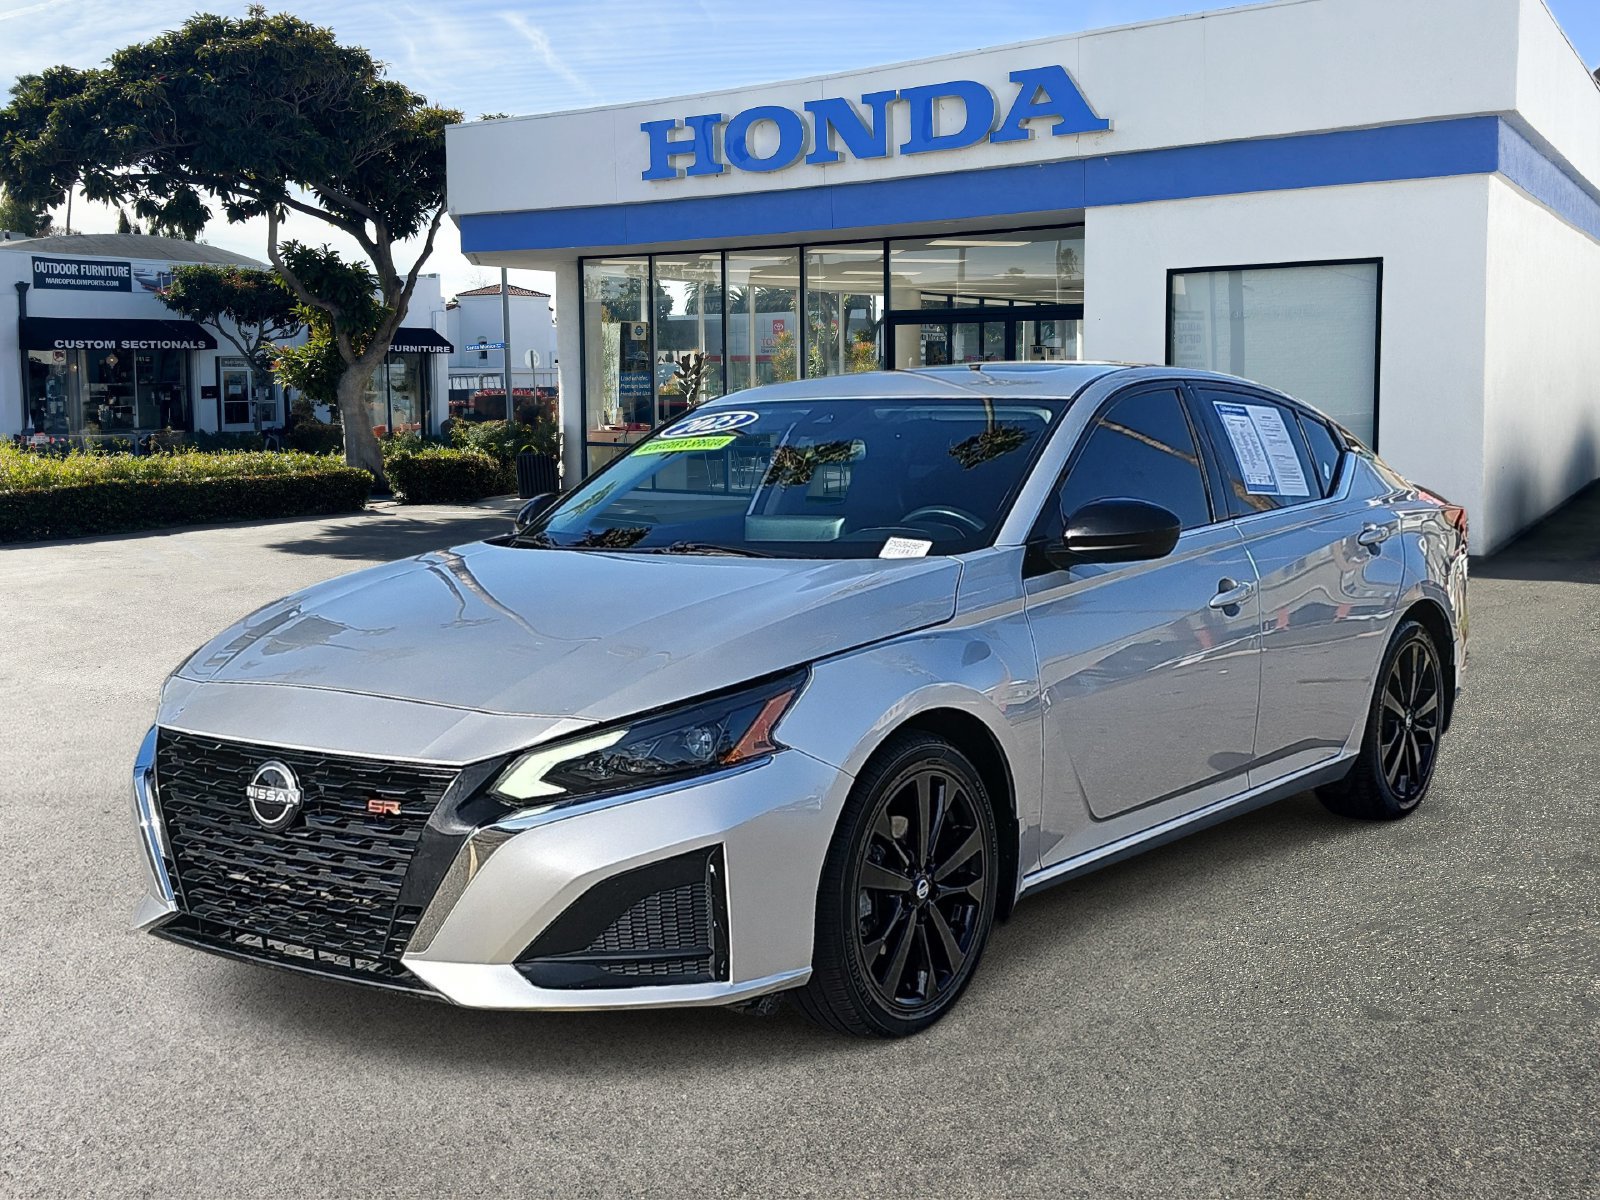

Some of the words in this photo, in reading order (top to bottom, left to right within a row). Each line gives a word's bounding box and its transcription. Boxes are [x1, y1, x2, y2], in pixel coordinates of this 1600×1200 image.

[640, 64, 1113, 182] HONDA
[34, 261, 79, 276] OUTDOOR
[80, 264, 130, 278] FURNITURE
[45, 277, 120, 287] MARCOPOLOIMPORTS.COM
[54, 339, 116, 349] CUSTOM
[121, 340, 206, 349] SECTIONALS
[388, 344, 451, 353] FURNITURE
[247, 785, 300, 805] NISSAN
[367, 799, 402, 815] SR
